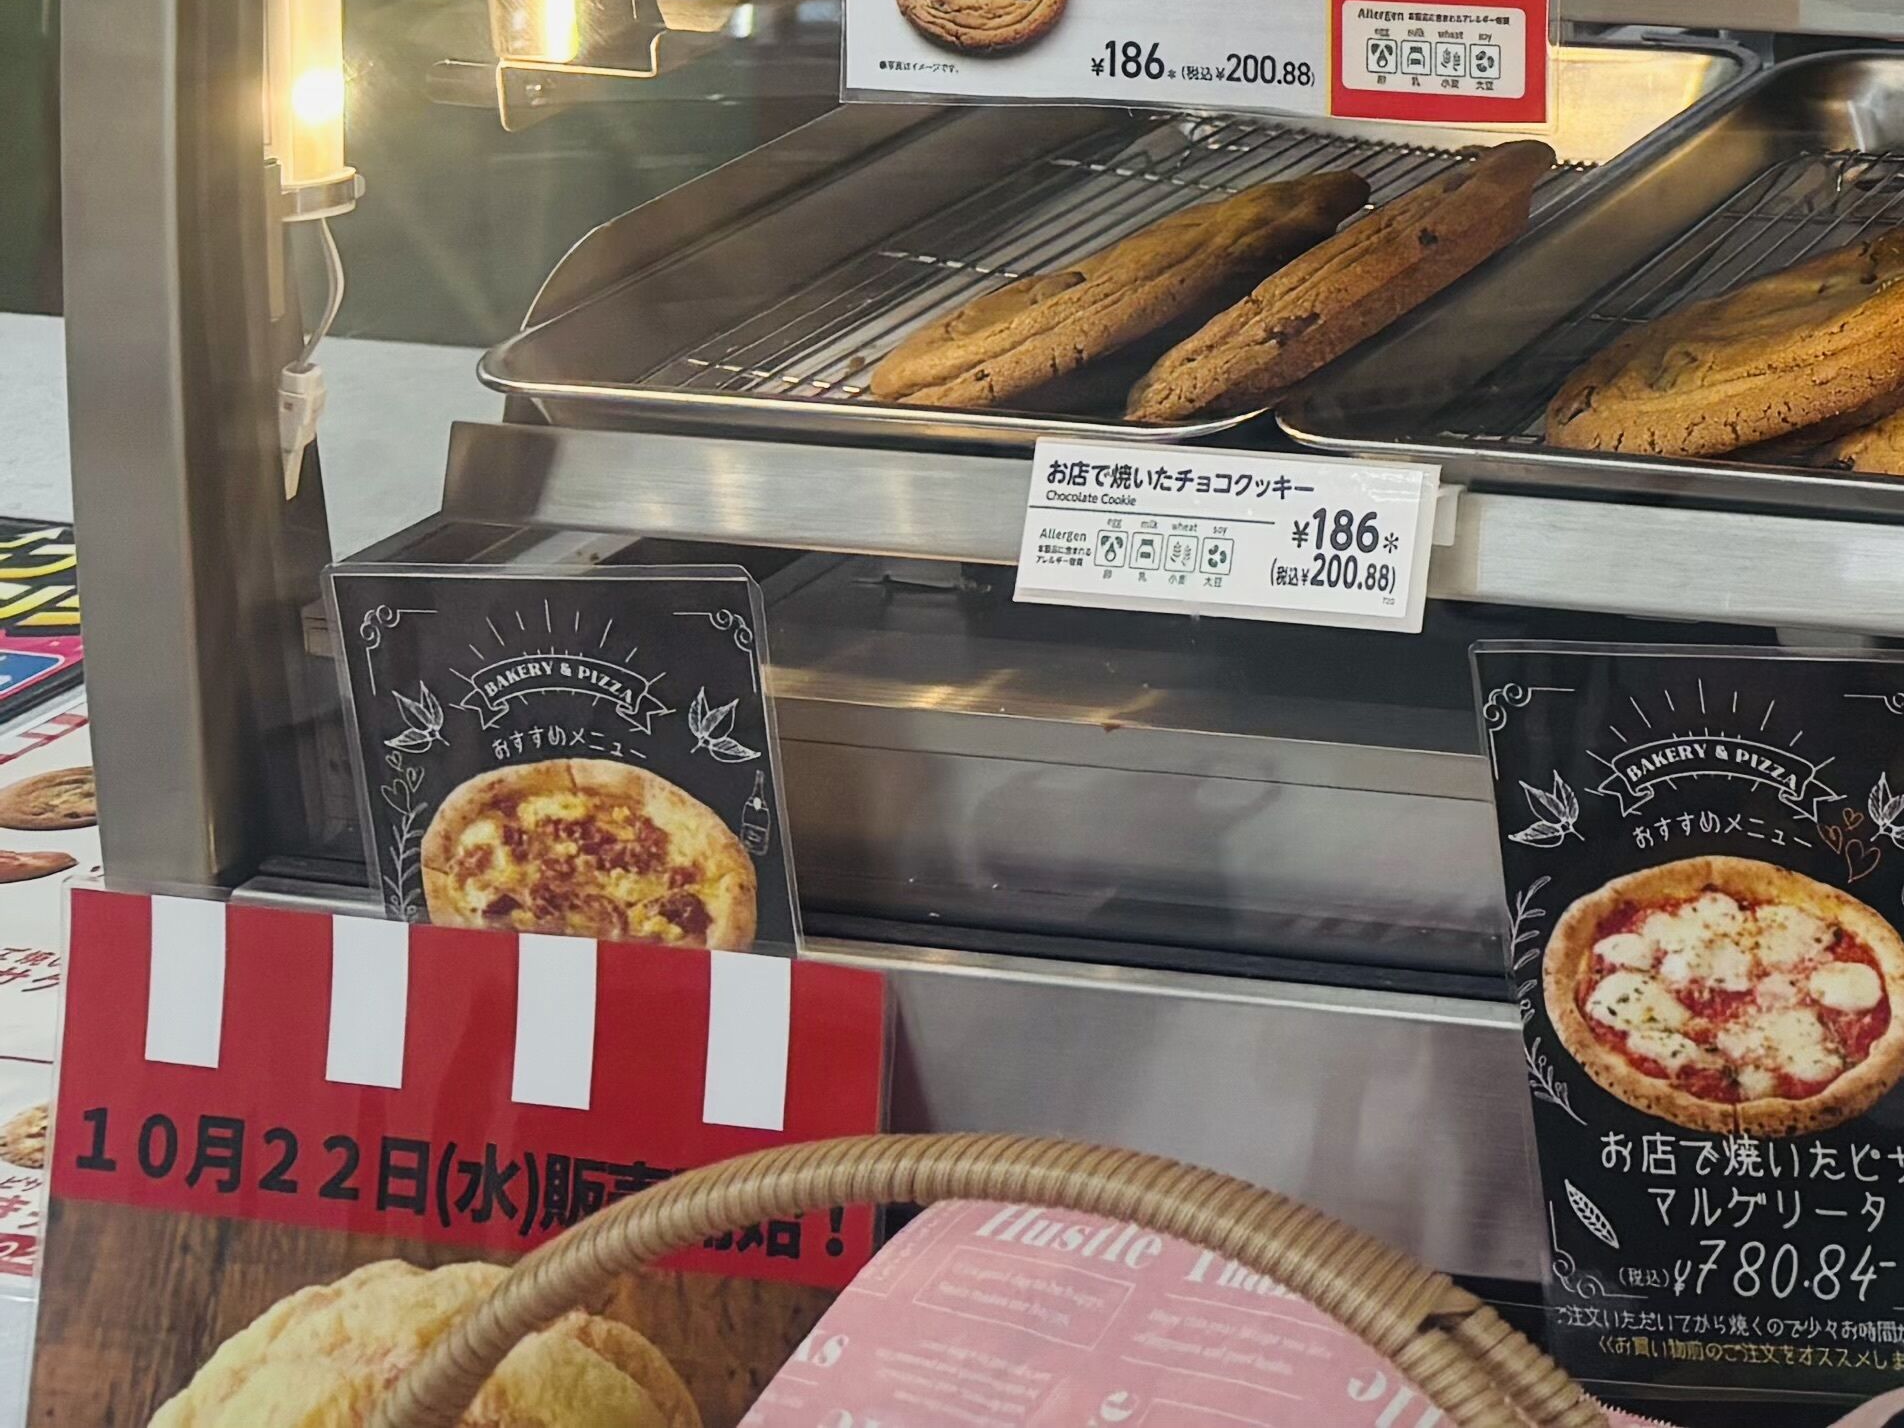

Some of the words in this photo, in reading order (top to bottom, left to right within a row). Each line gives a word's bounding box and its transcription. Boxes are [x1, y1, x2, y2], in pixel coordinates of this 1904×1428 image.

[1046, 458, 1315, 501] お店で焼いたチョコクッキー
[1046, 490, 1098, 505] Chocolate
[1100, 492, 1137, 508] Cookie
[1039, 527, 1087, 544] Allergen
[484, 660, 554, 698] BAKERY
[560, 661, 572, 676] &
[578, 664, 633, 705] PIZZA
[492, 725, 648, 761] おすすめメニュー
[1627, 743, 1708, 783] BAKERY
[1715, 744, 1728, 760] &
[1735, 747, 1798, 792] PIZZA
[1632, 811, 1813, 849] おすすめメニュー
[1647, 1186, 1887, 1233] マルゲリータ
[1618, 1265, 1670, 1289] (税込)
